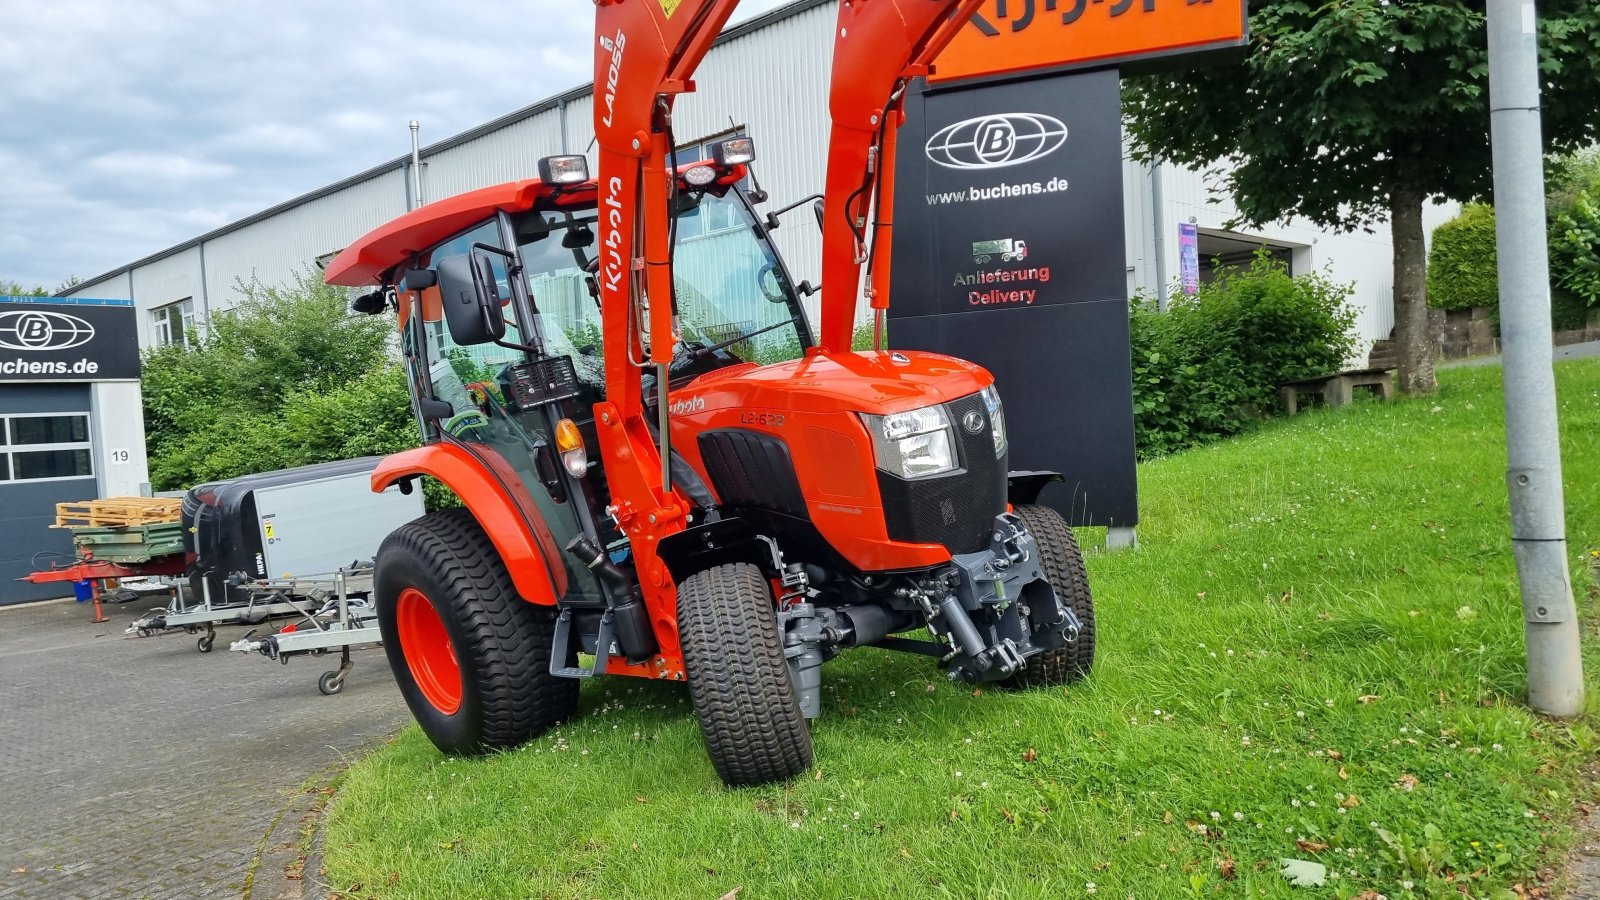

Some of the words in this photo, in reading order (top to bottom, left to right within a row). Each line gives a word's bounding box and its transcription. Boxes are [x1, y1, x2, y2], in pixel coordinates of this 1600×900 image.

[602, 28, 626, 128] LA1055
[926, 177, 1069, 205] www.buchens.de
[605, 176, 622, 292] Kubota
[953, 266, 1050, 286] Anlieferung
[968, 289, 1036, 305] Delivery
[0, 358, 99, 374] chens.de
[668, 395, 705, 415] ubota
[112, 450, 129, 462] 19
